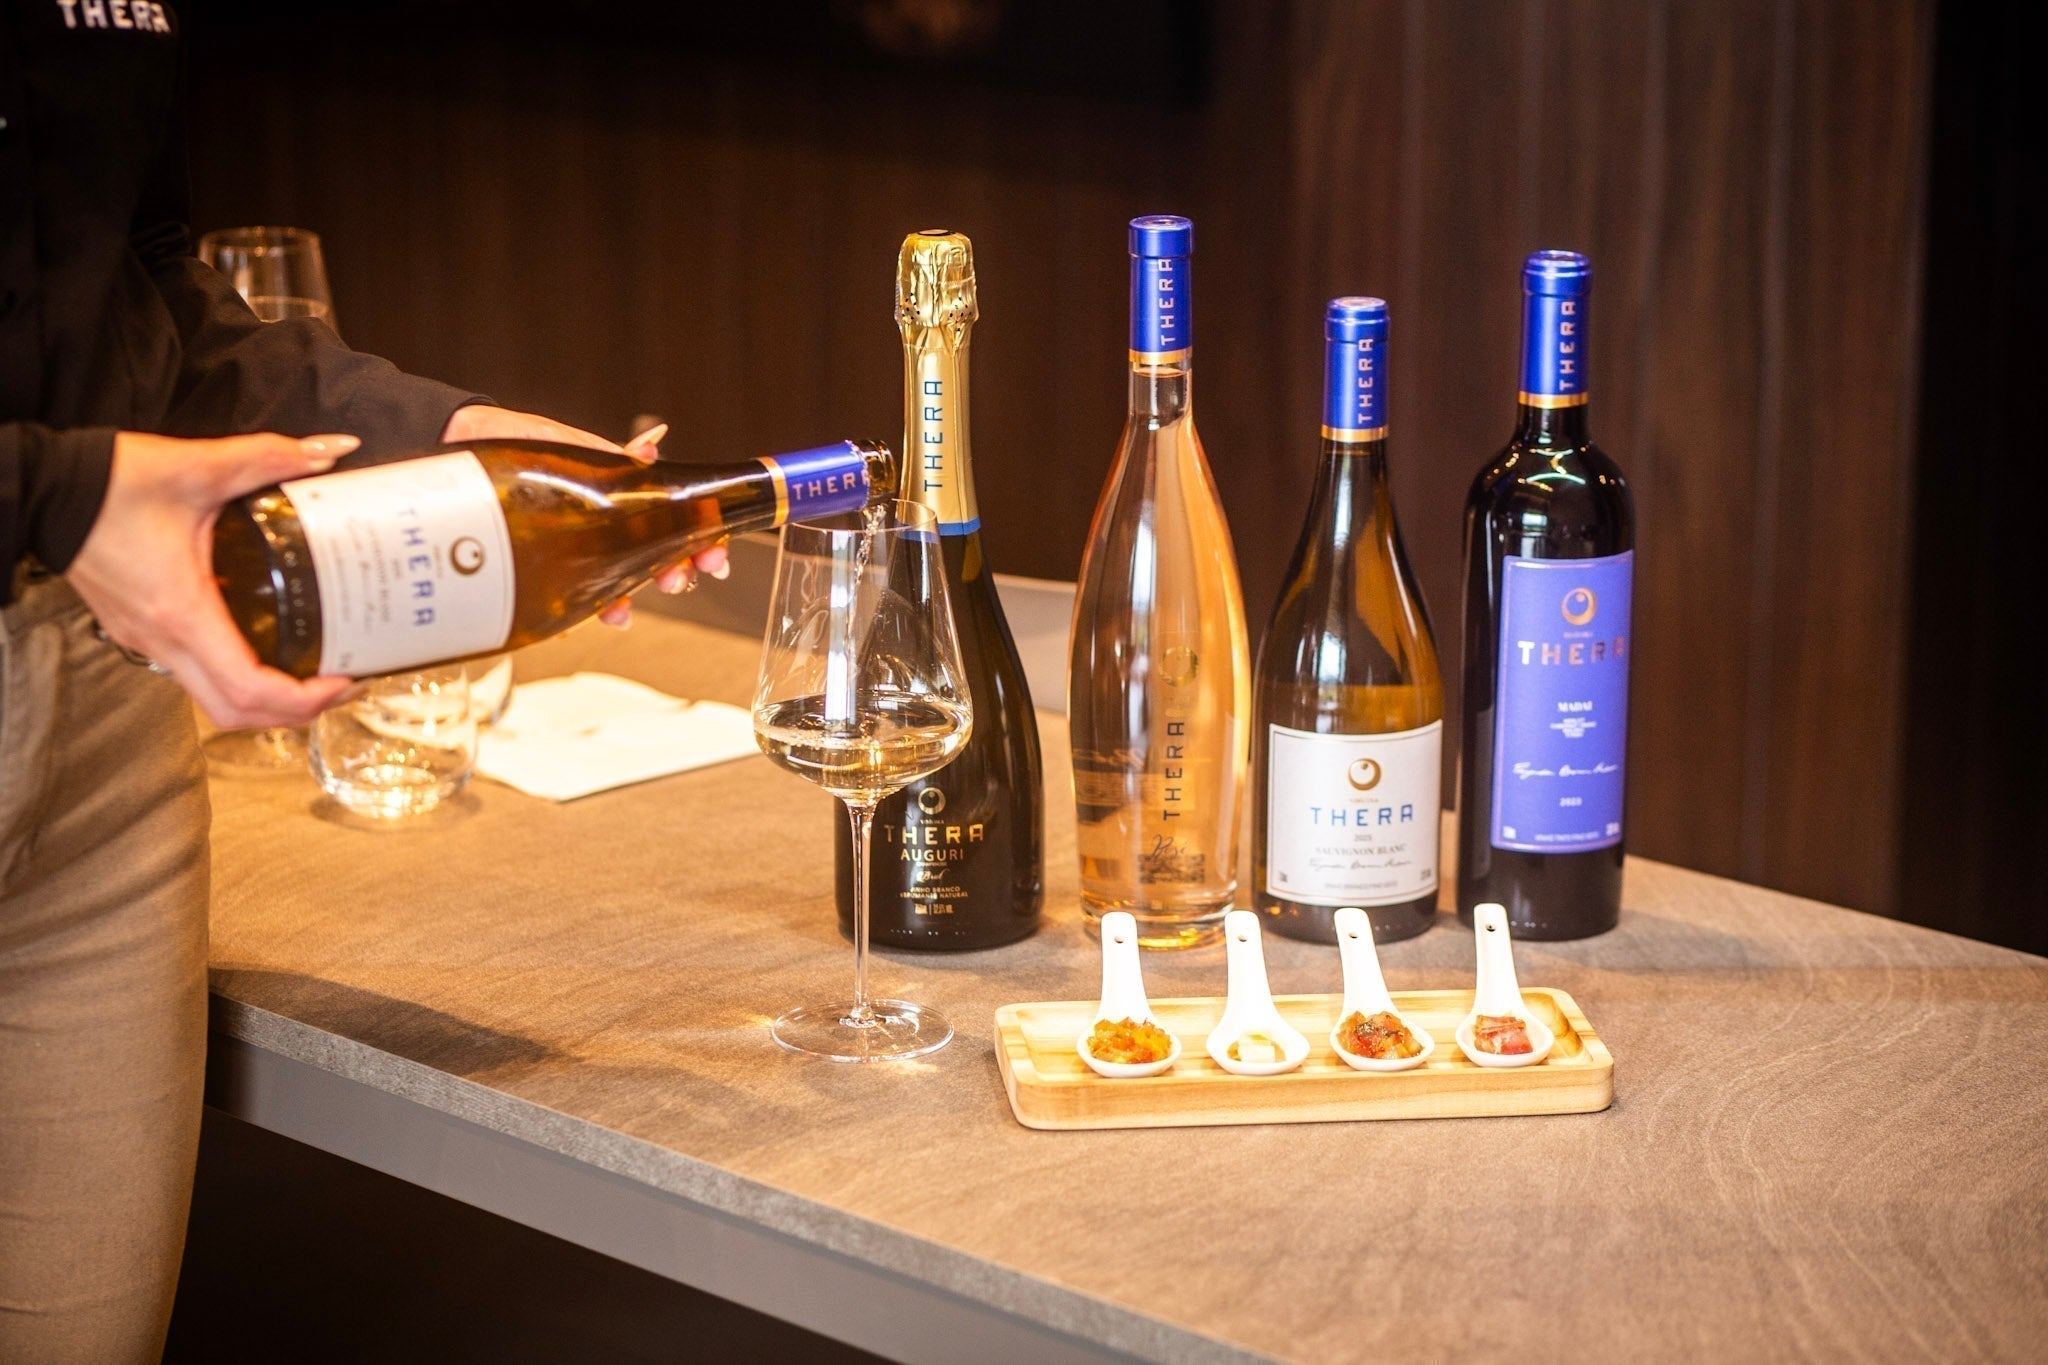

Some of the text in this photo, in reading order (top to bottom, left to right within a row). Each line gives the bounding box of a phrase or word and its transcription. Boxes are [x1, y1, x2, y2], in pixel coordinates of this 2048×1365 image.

[56, 0, 171, 33] THERA
[1158, 258, 1175, 346] THERA
[1560, 301, 1576, 391] THERA
[1358, 338, 1373, 424] THERA
[924, 380, 943, 492] THERA
[398, 507, 435, 628] THERA
[1518, 636, 1625, 666] THERA
[1163, 722, 1185, 821] THERA
[884, 823, 984, 845] THERA
[1310, 804, 1413, 827] THERA
[901, 849, 964, 862] AUGURI
[932, 885, 961, 893] BRANCO
